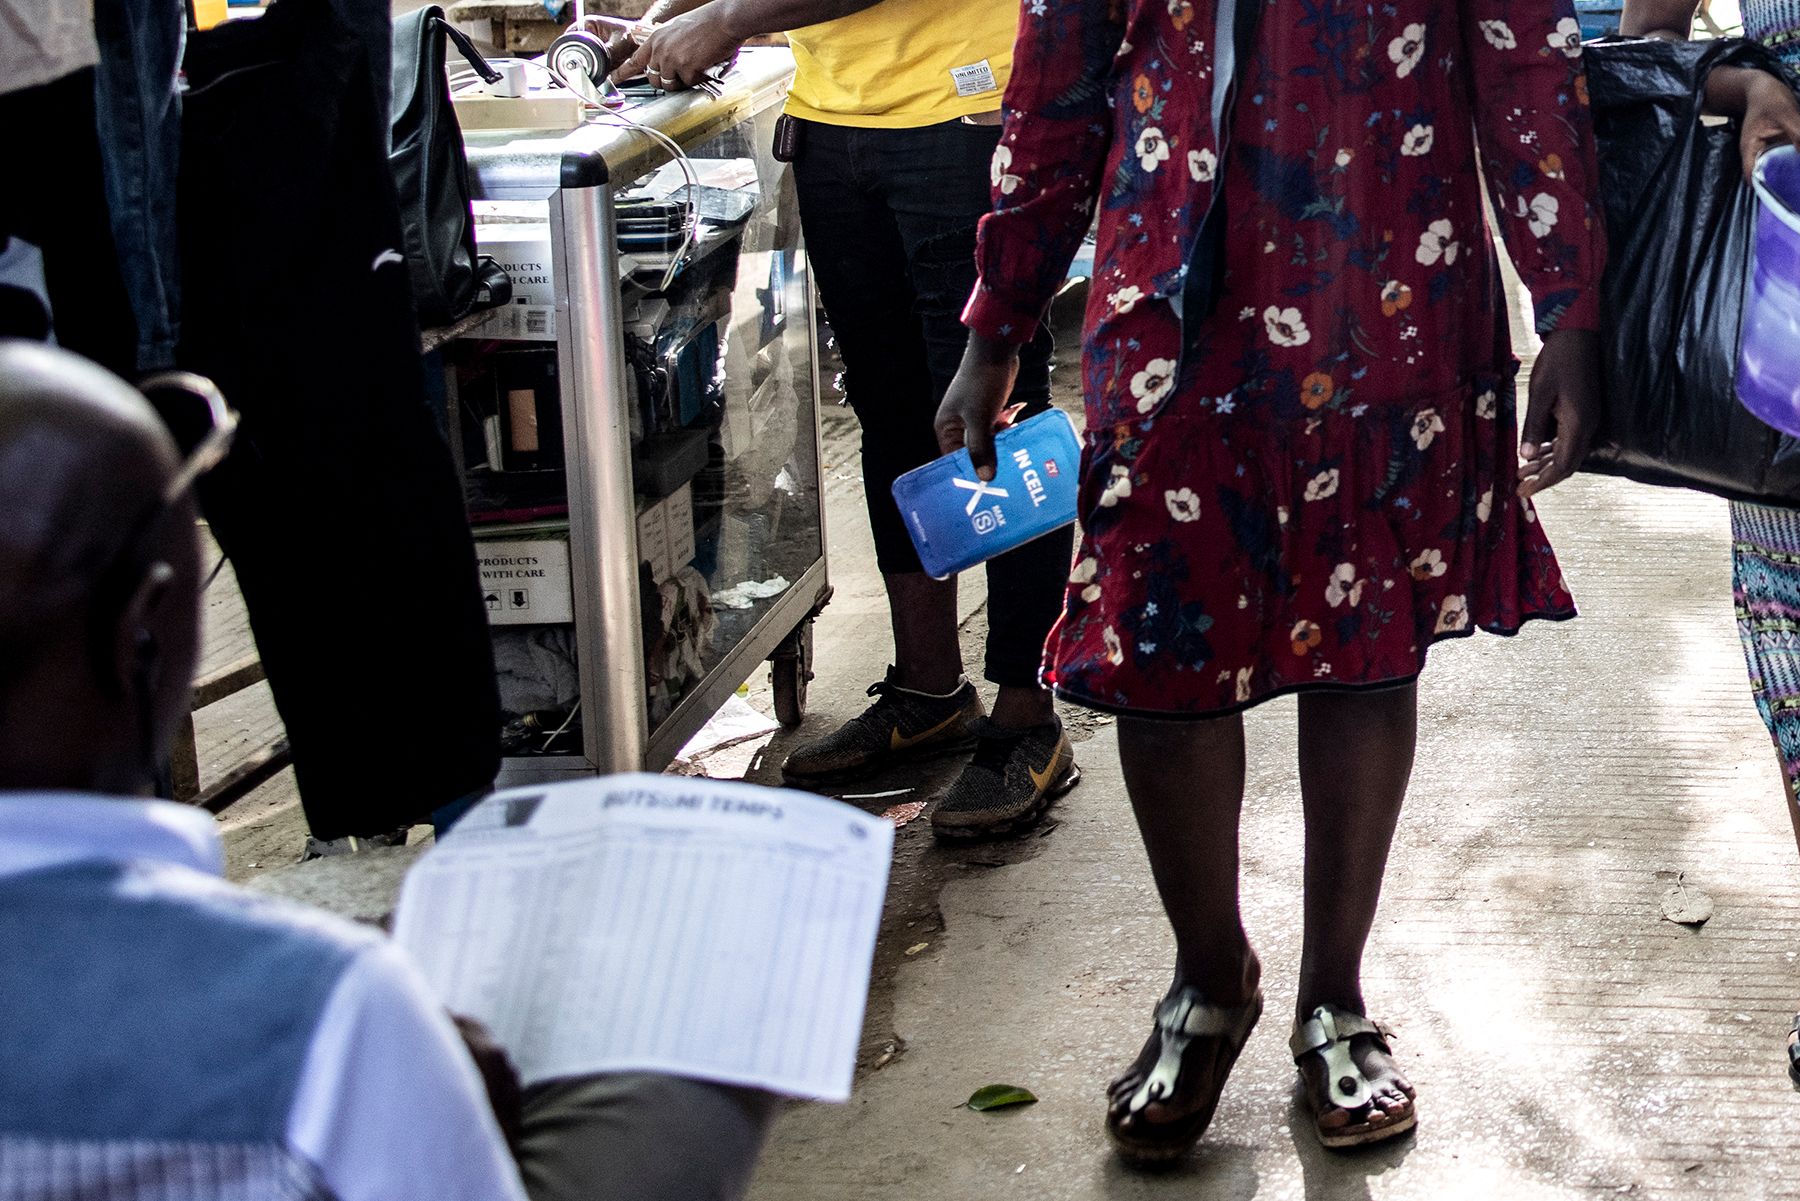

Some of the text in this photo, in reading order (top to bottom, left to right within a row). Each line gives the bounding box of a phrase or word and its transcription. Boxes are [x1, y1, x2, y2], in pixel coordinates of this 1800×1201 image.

[503, 263, 542, 272] DUCTS
[520, 275, 550, 285] CARE
[1012, 448, 1047, 507] IN CELL
[952, 477, 1009, 516] X
[992, 504, 1006, 526] MAX
[482, 569, 546, 579] WITH CARE
